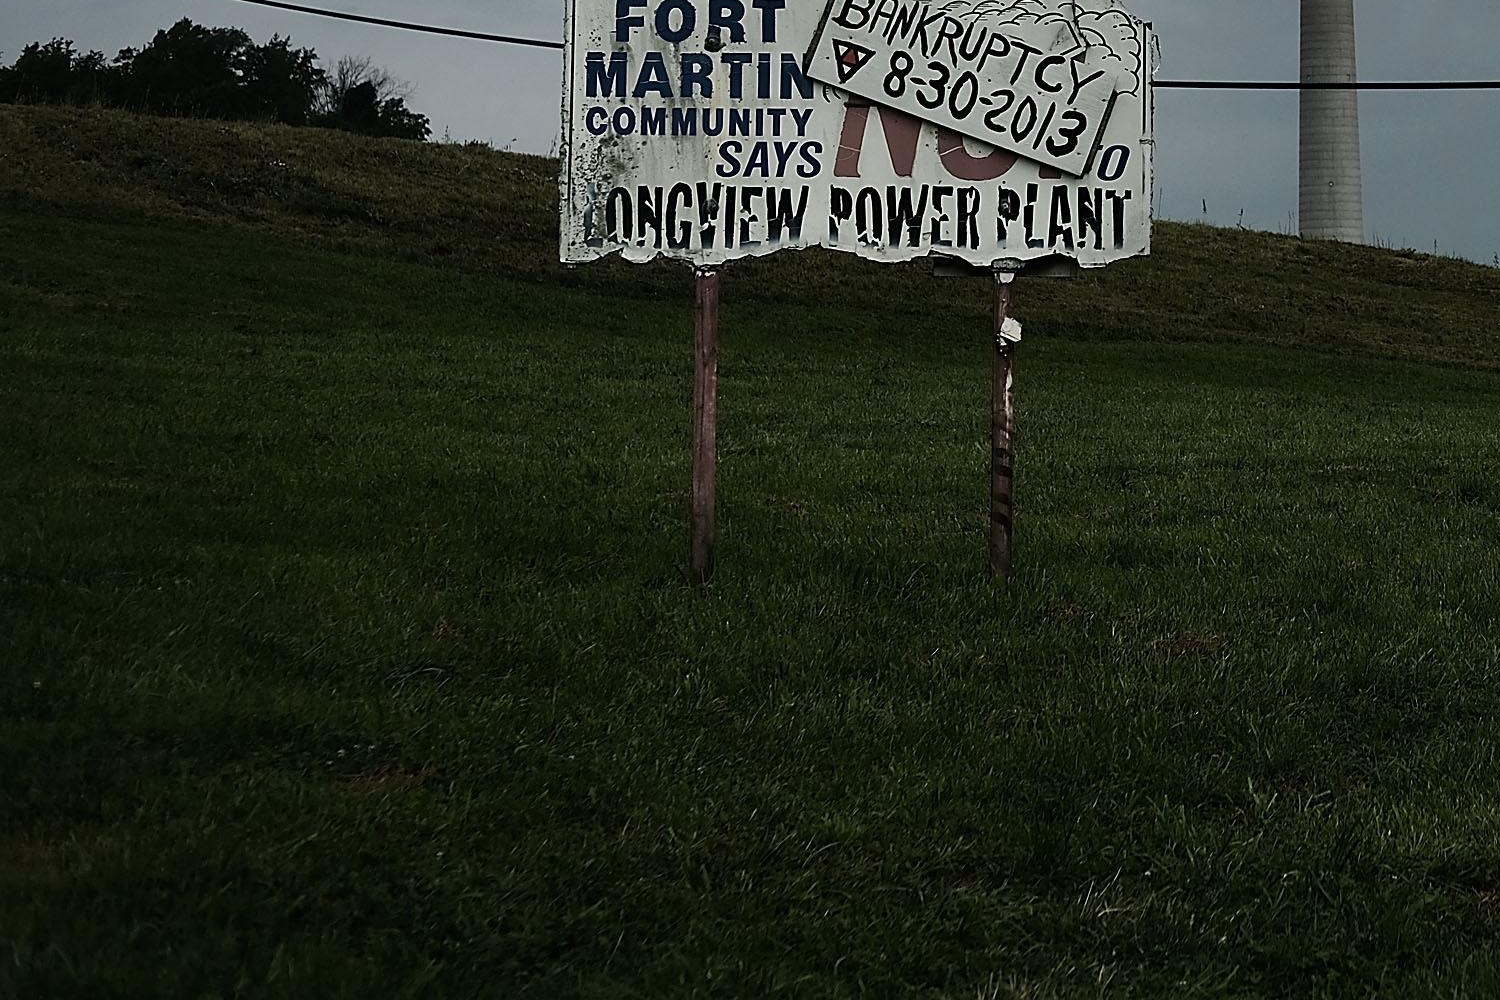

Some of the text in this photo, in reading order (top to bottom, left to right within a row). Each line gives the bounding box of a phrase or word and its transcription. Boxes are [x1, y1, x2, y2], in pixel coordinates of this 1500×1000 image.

[585, 51, 814, 99] MARTIN
[585, 106, 814, 137] COMMUNITY
[882, 50, 1087, 157] 8-30-2013
[715, 140, 823, 178] SAYS
[1097, 144, 1131, 181] O
[828, 184, 981, 250] POWER
[996, 182, 1132, 250] PLANT
